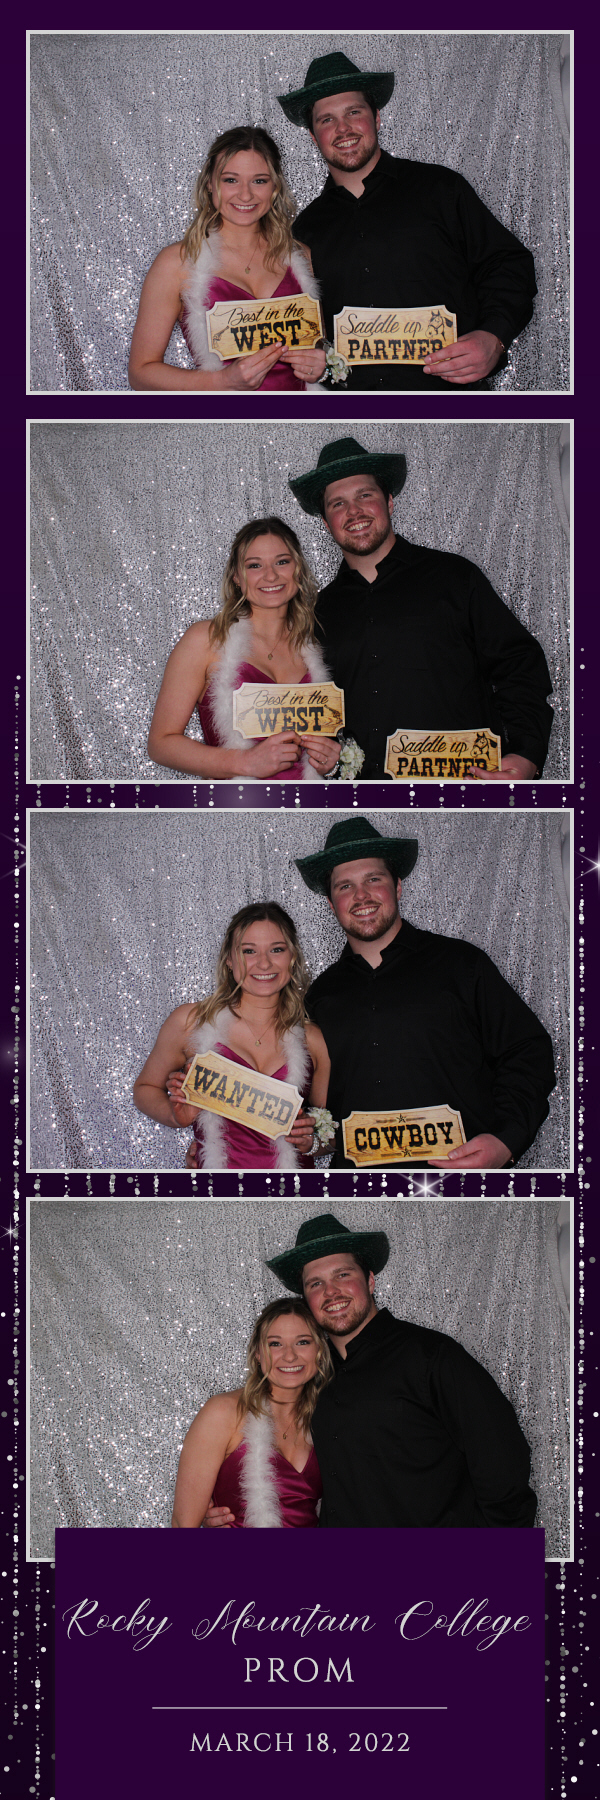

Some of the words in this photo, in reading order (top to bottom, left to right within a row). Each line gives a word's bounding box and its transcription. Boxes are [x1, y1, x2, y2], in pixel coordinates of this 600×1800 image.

[213, 307, 262, 326] Best
[265, 307, 281, 320] in
[283, 303, 304, 318] the
[340, 313, 400, 337] Saddle
[404, 323, 423, 337] up
[230, 319, 302, 352] WEST
[238, 690, 289, 706] Best
[291, 691, 304, 704] in
[307, 690, 329, 705] the
[255, 706, 324, 733] WEST
[392, 735, 447, 756] Saddle
[451, 742, 469, 757] up
[193, 1064, 295, 1127] WANTED
[354, 1121, 454, 1151] COWBOY
